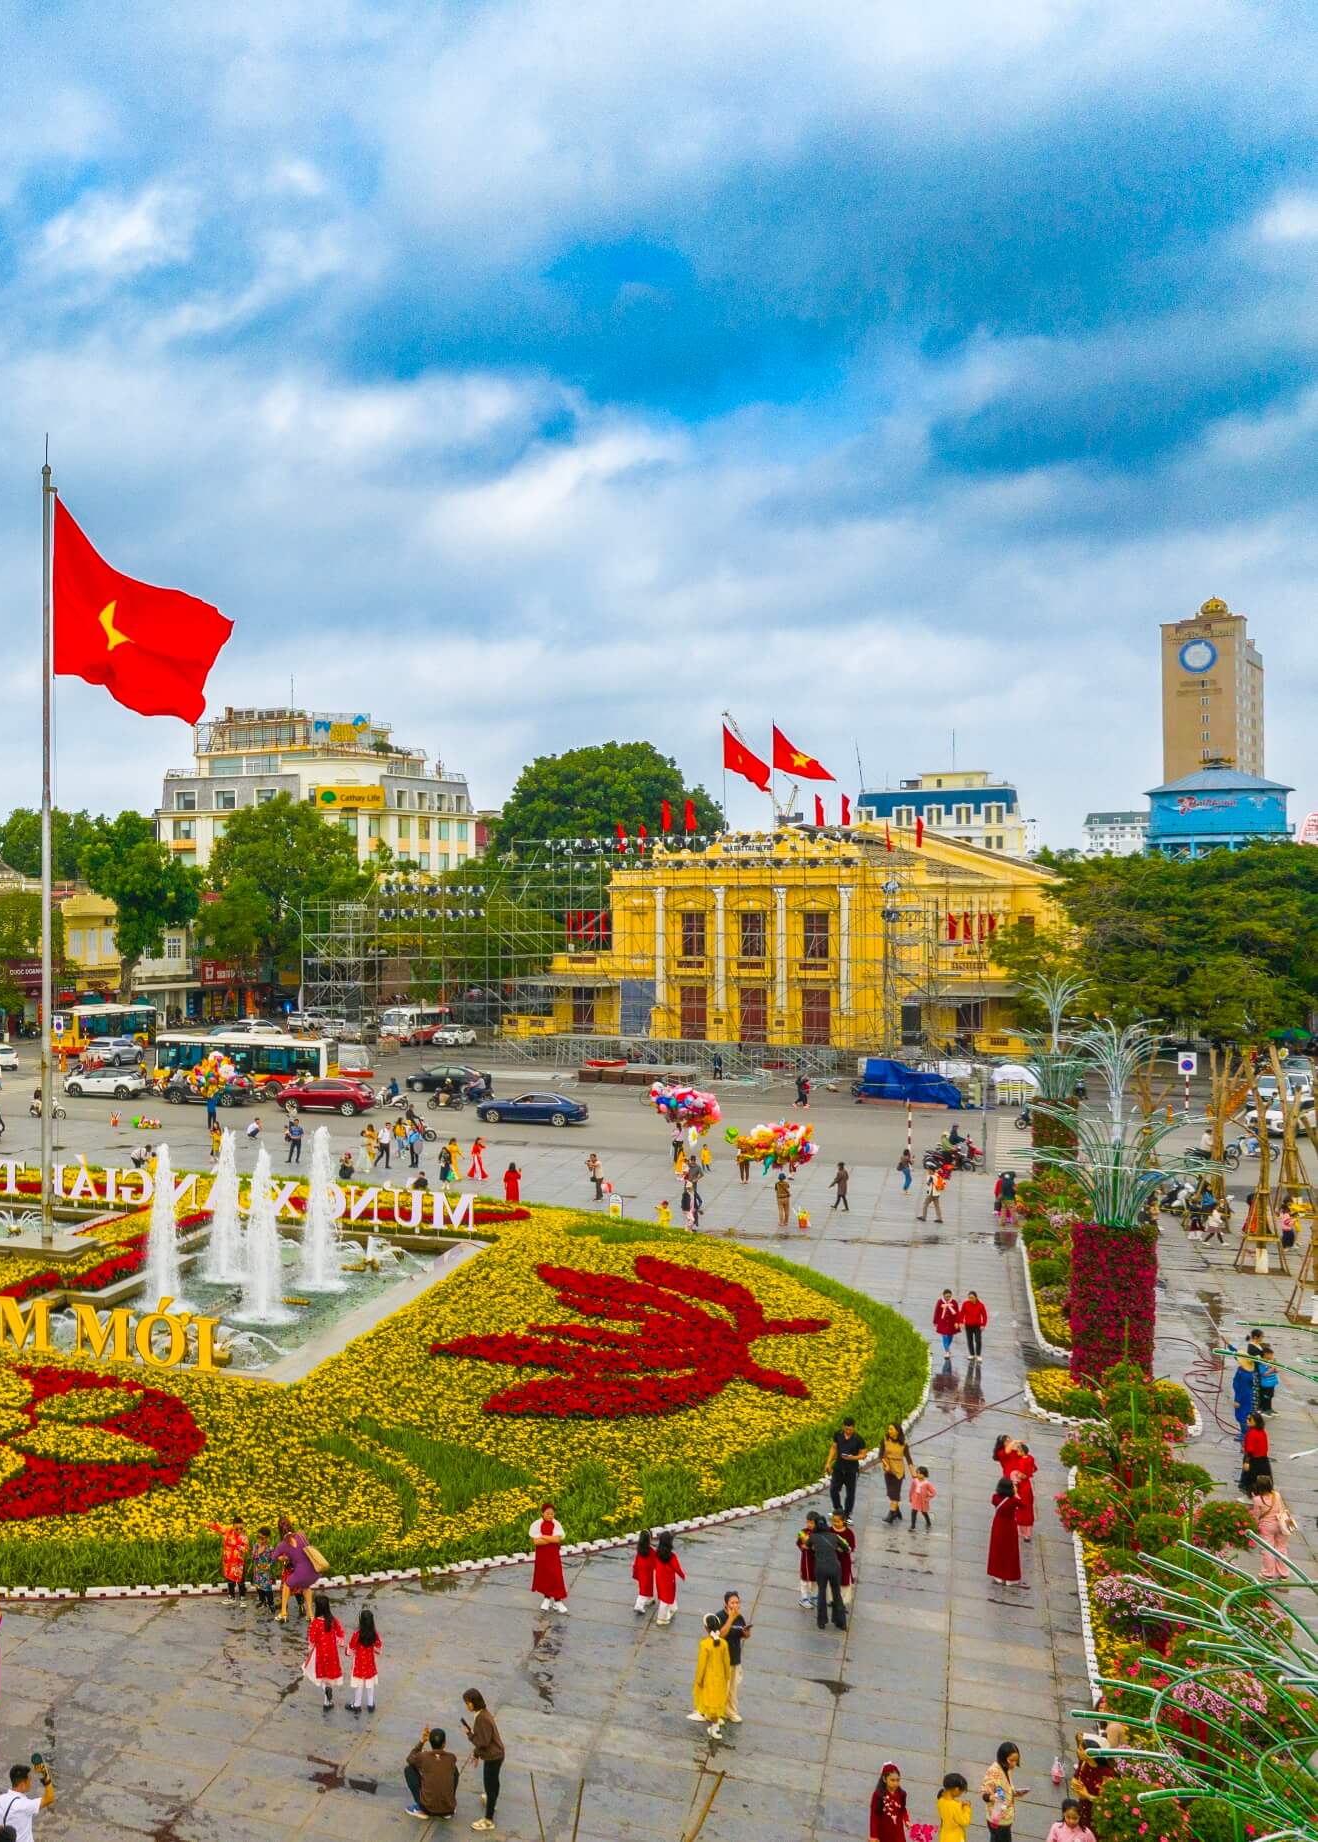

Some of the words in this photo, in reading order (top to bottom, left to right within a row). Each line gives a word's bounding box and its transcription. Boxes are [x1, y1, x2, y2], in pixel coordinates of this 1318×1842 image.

[340, 793, 366, 803] Cathay
[367, 794, 380, 802] Life
[71, 1296, 221, 1374] MỚI
